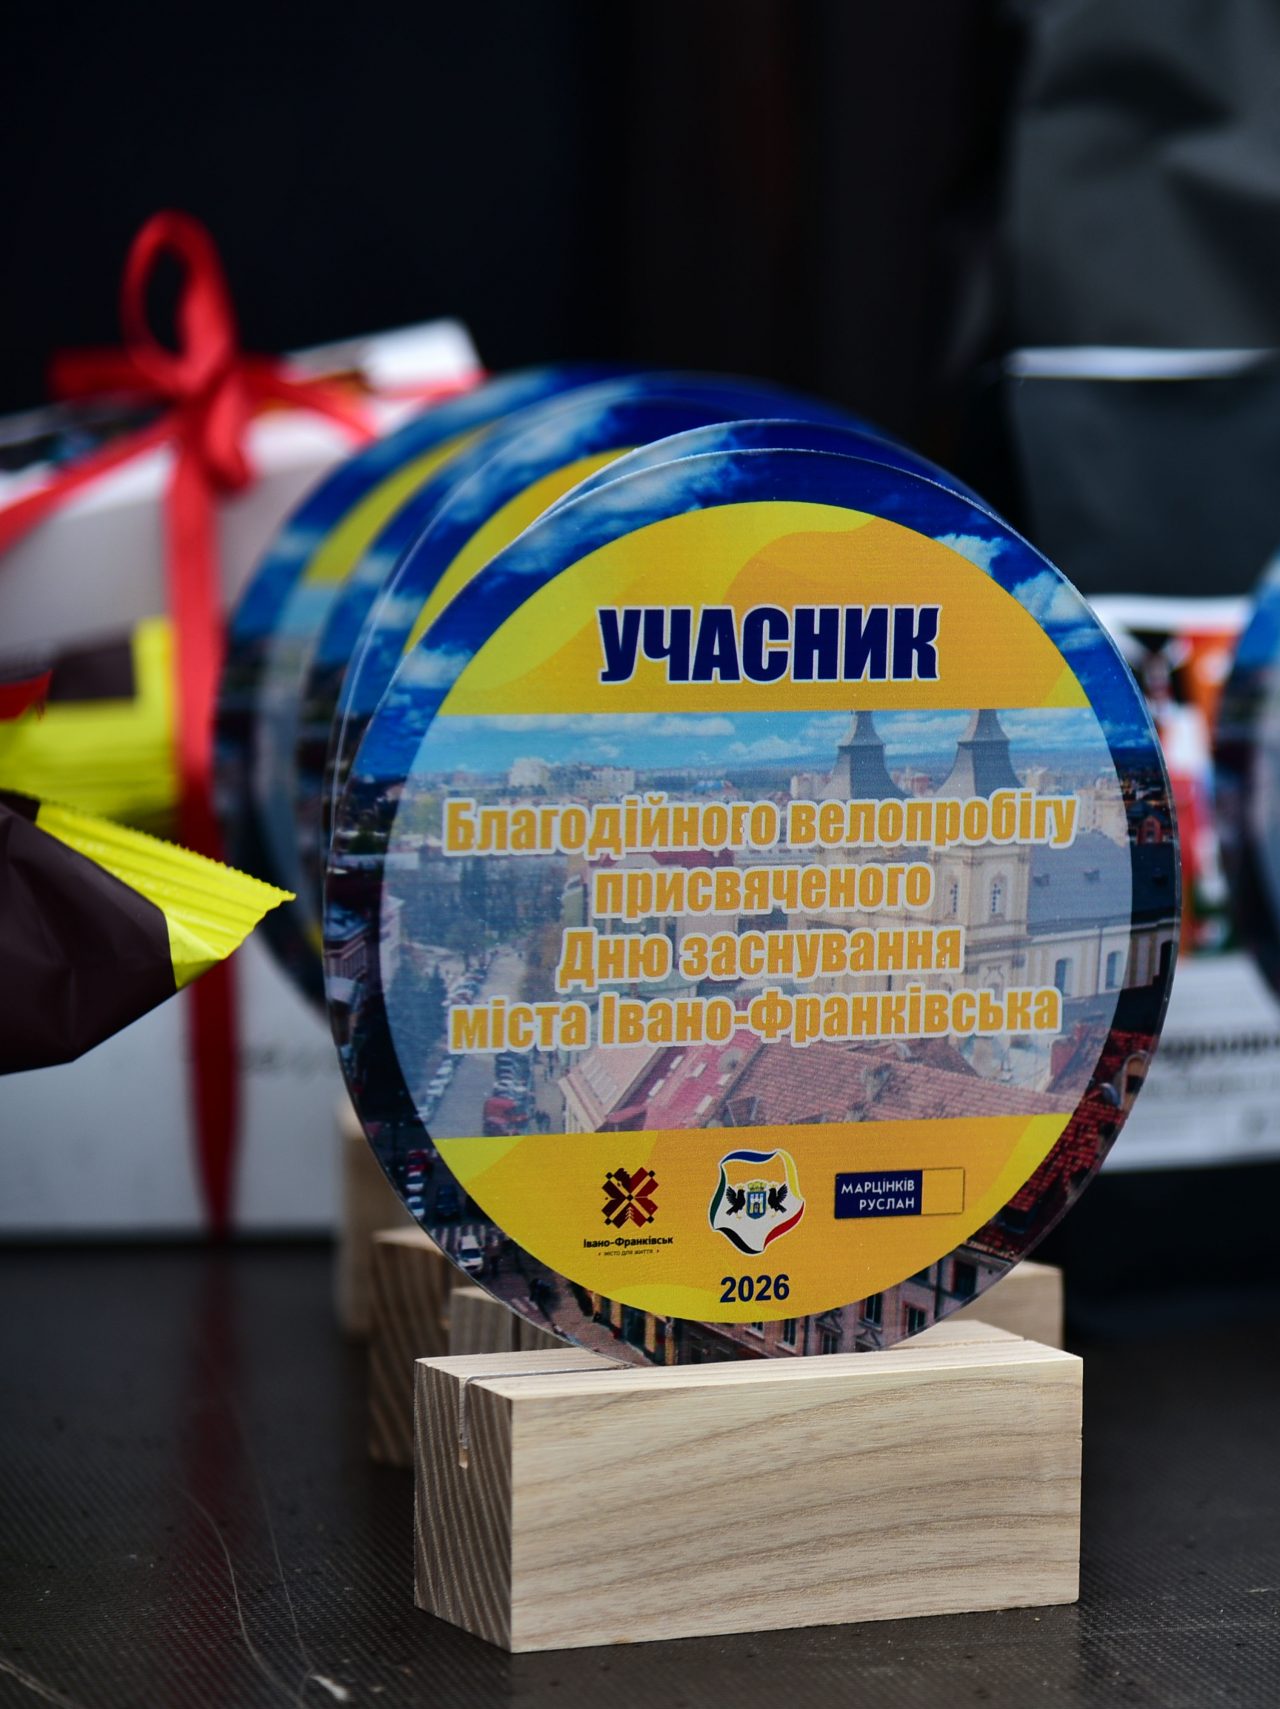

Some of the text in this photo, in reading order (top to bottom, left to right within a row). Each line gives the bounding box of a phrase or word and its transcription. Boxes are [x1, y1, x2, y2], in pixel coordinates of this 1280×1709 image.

[598, 605, 941, 684] УЧАСНИК
[442, 791, 1077, 857] Благодійного велопробігу
[593, 861, 934, 921] присвяченого
[556, 925, 965, 992] Дню заснування
[449, 985, 1062, 1053] міста Івано-Франківська
[841, 1178, 915, 1195] МАРЦІНКІВ
[859, 1197, 915, 1211] РУСЛАН
[583, 1236, 674, 1248] Івано-Франківськ
[720, 1274, 789, 1303] 2026
